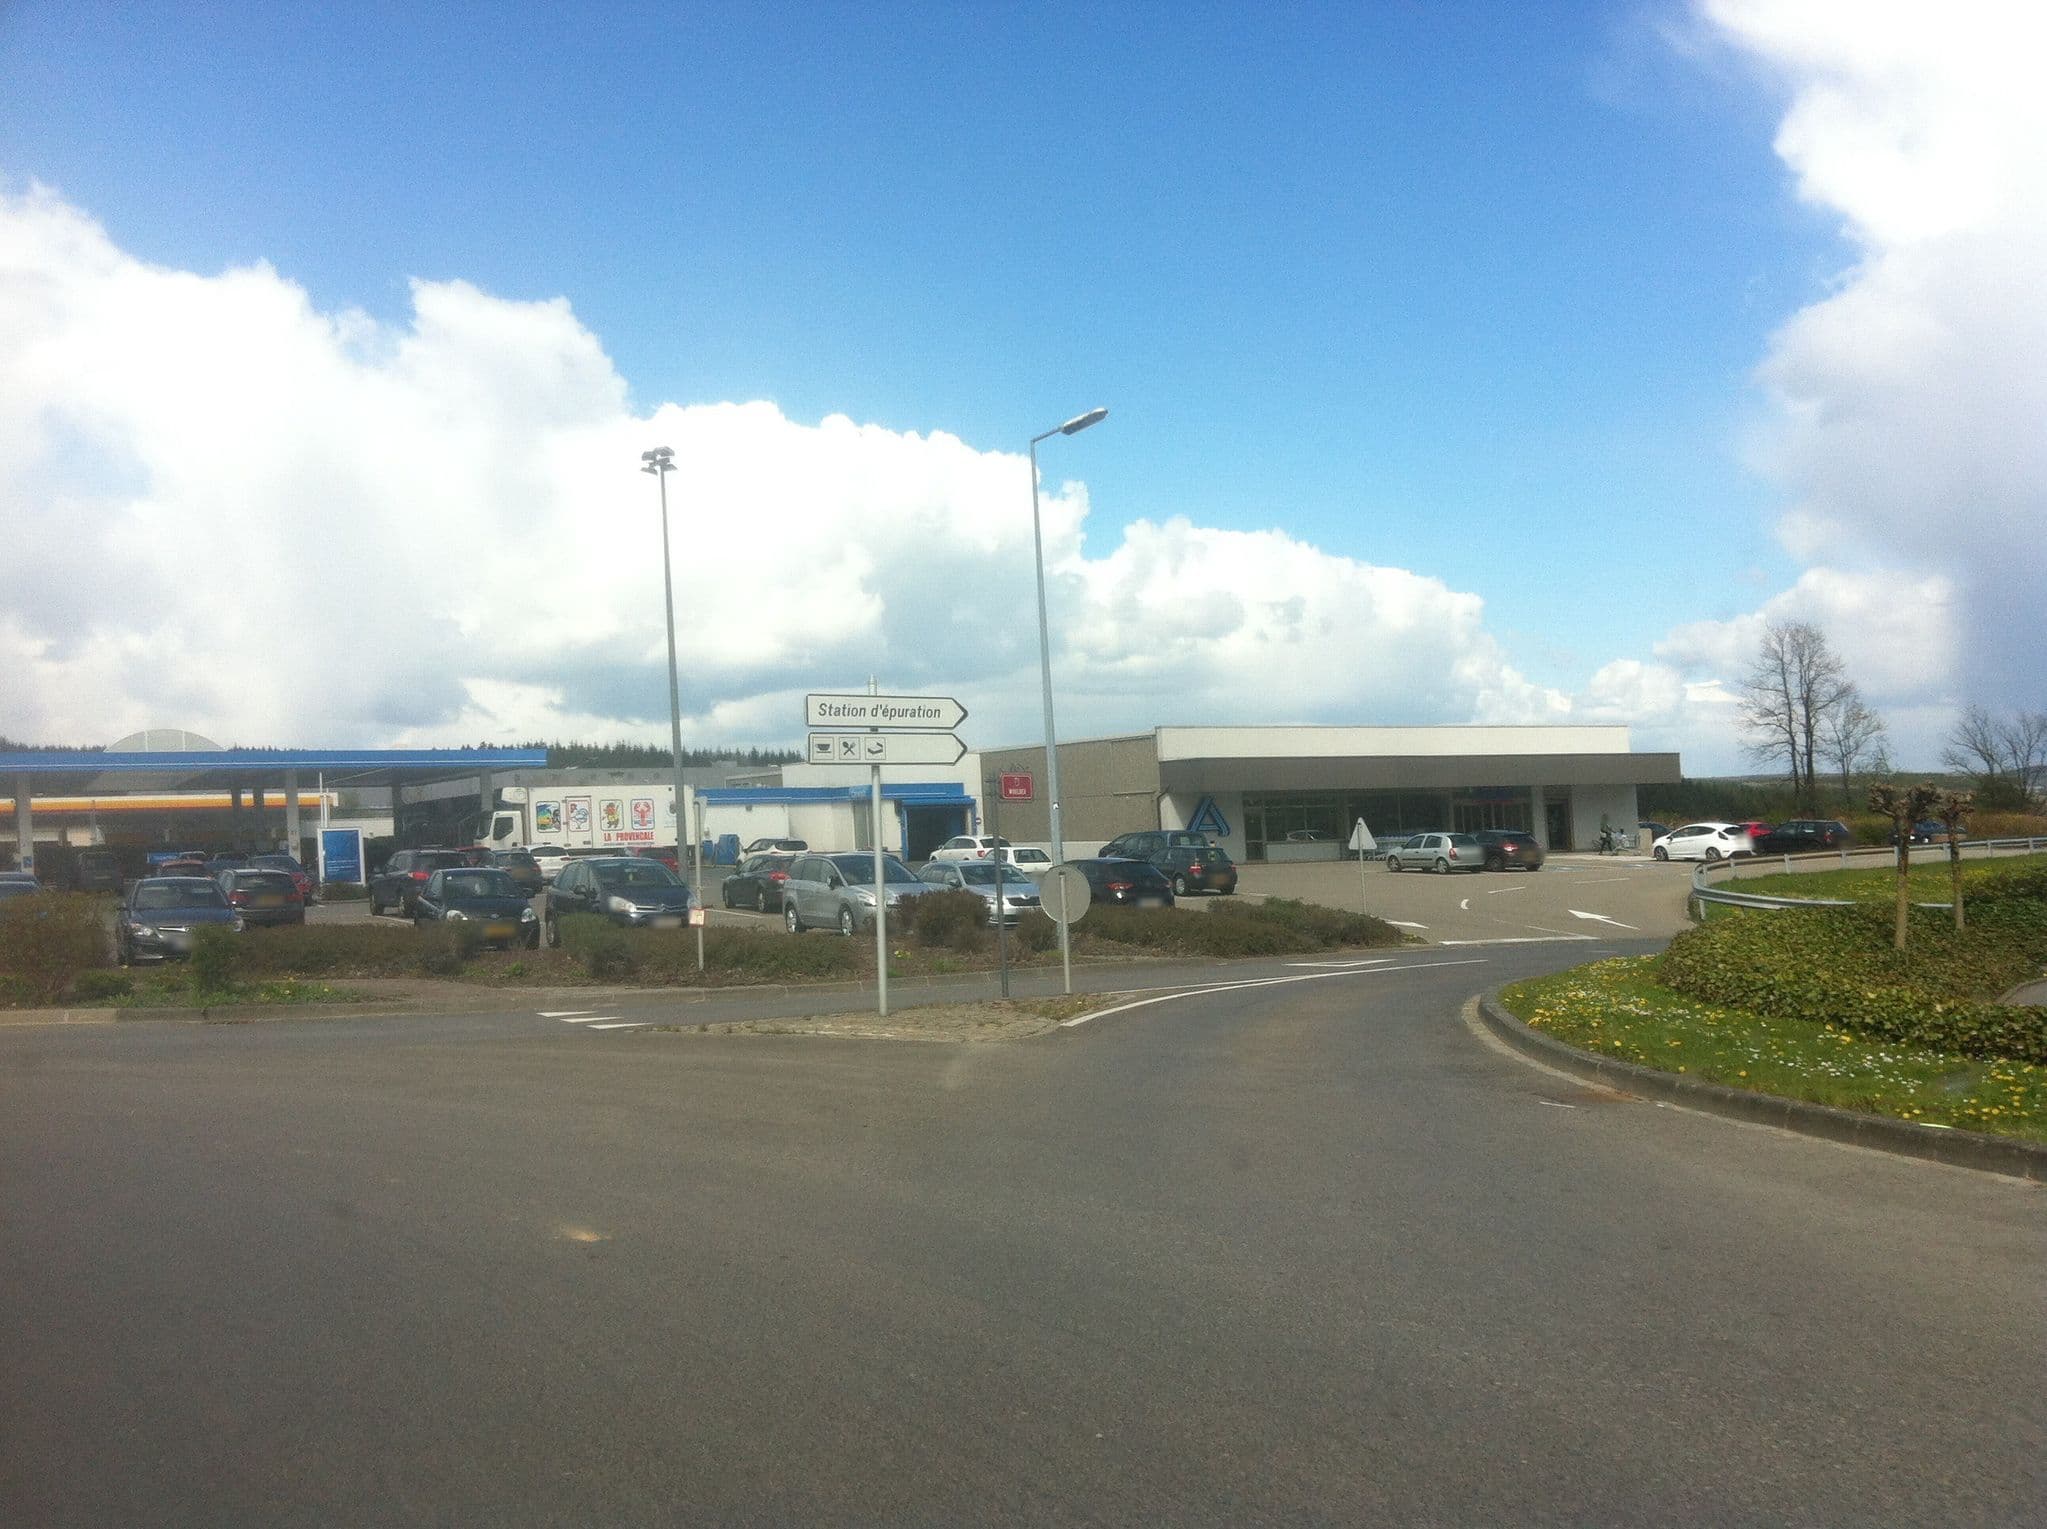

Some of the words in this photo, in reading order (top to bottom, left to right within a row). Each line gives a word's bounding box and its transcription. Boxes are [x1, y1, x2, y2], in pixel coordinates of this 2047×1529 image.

[818, 702, 866, 718] Station
[870, 704, 941, 721] d'épuration
[603, 832, 612, 842] LA
